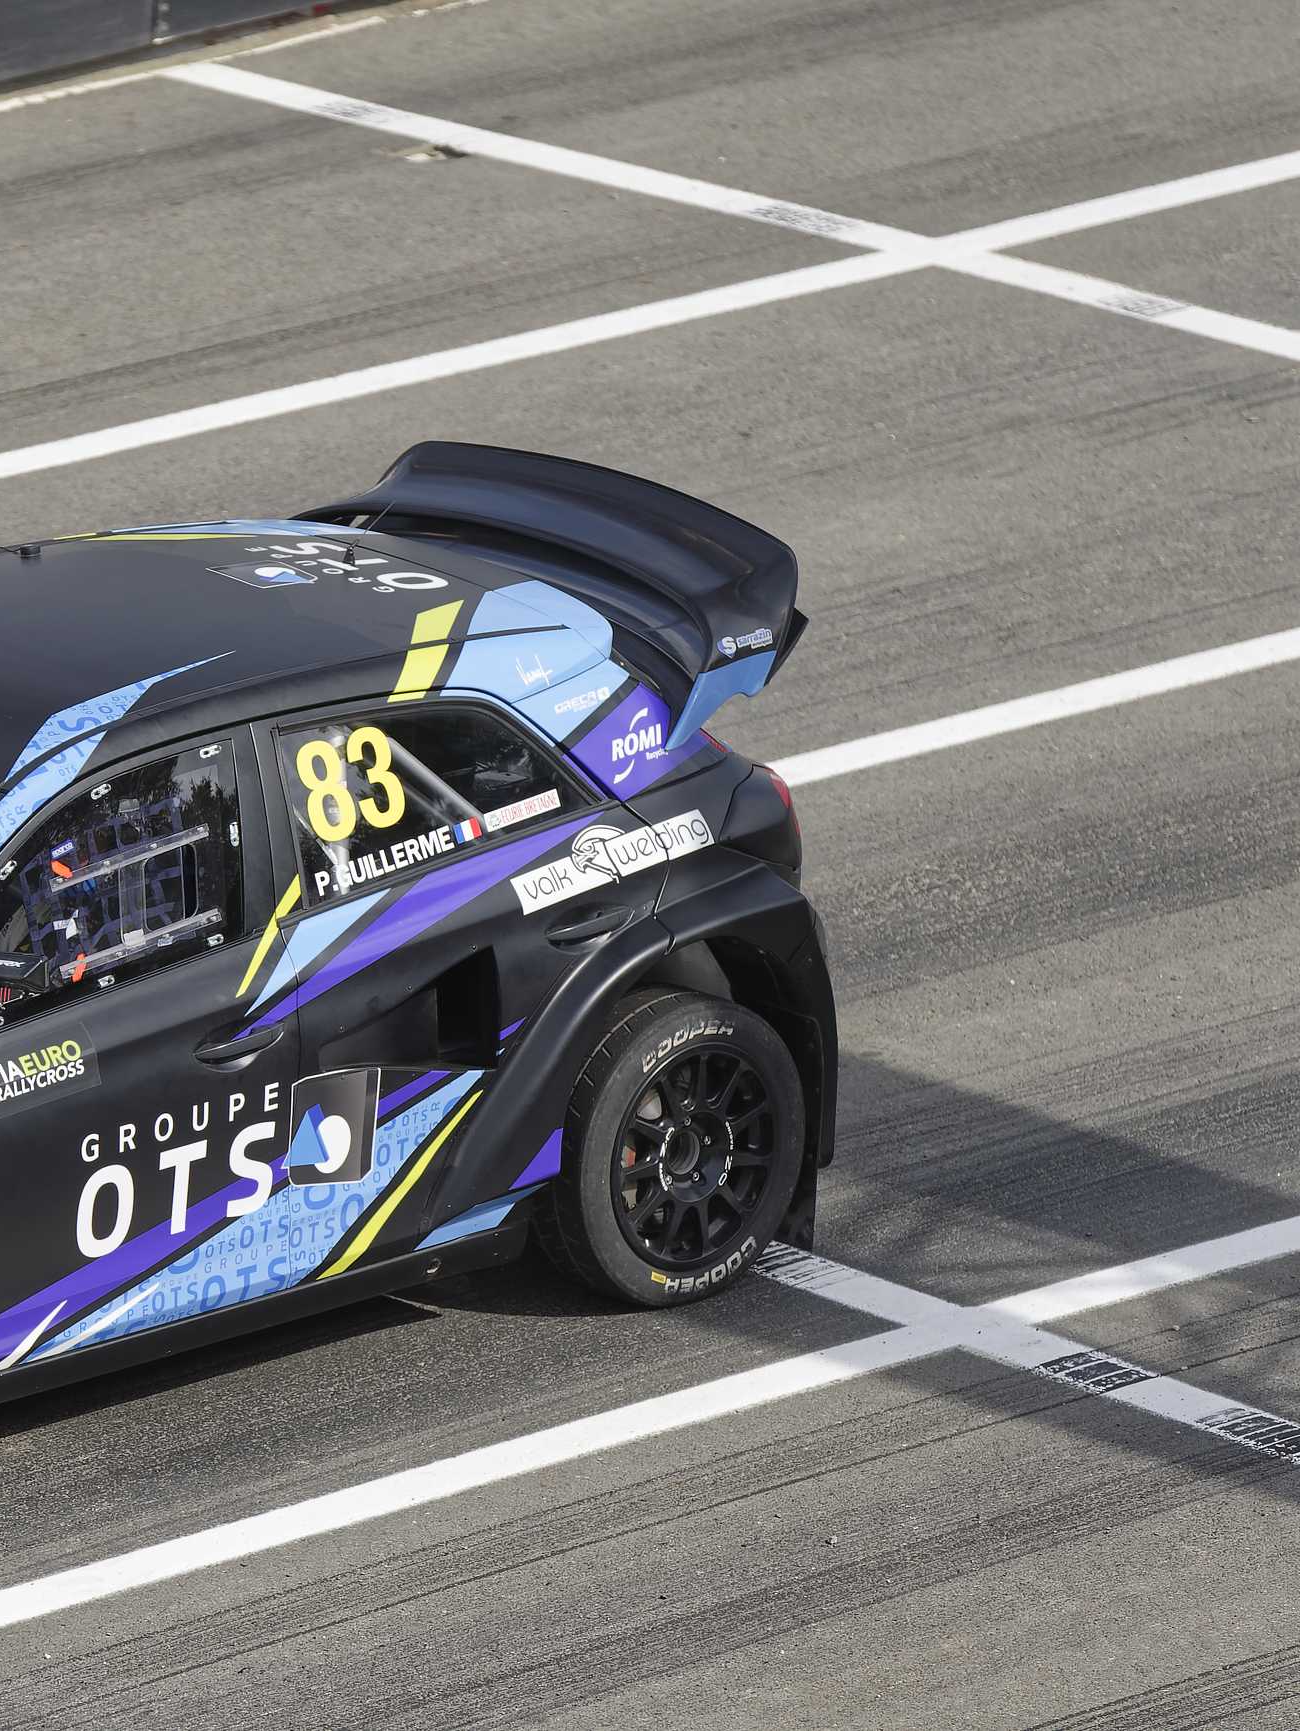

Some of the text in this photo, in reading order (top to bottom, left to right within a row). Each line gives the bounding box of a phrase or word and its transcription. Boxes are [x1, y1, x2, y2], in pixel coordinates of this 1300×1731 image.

[244, 547, 395, 593] GROUPE
[612, 723, 661, 762] ROMI
[297, 727, 405, 842] 83
[524, 817, 709, 900] valk welding
[641, 1019, 735, 1073] COOPER
[81, 1082, 280, 1163] GROUPE
[76, 1121, 276, 1258] OTS
[664, 1236, 757, 1294] COOPER
